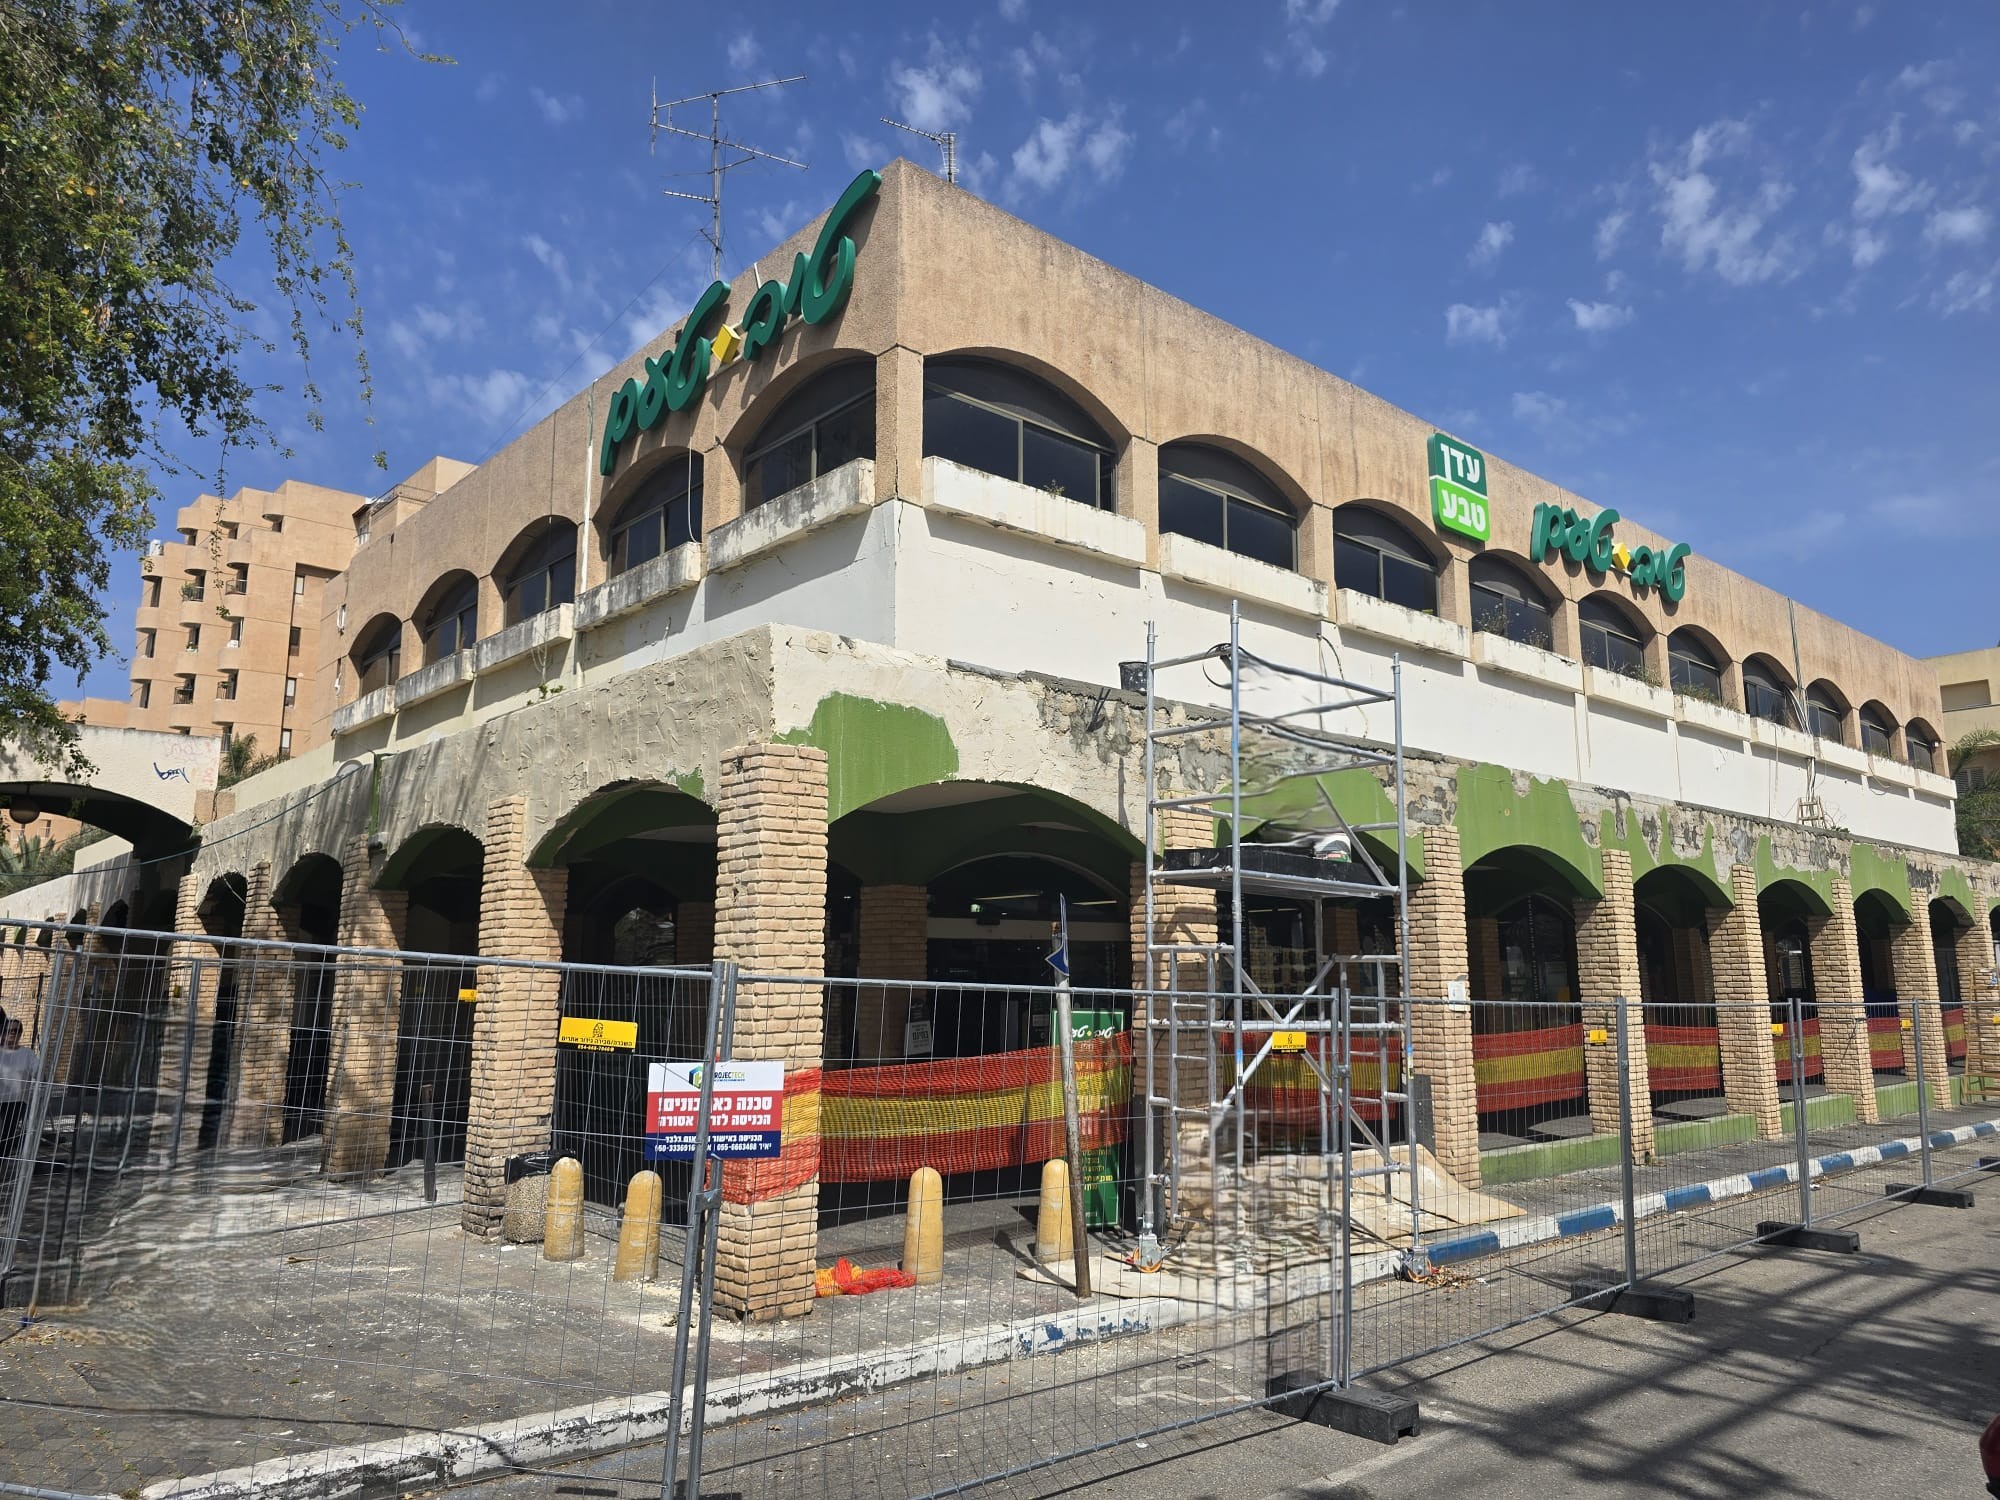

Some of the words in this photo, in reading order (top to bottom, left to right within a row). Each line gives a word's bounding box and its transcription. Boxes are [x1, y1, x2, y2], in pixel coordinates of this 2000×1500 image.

[743, 169, 882, 361] טיב
[600, 280, 731, 476] טעם
[1440, 443, 1480, 483] עדן
[1442, 489, 1486, 532] טבע
[1531, 502, 1620, 572] טעם
[1629, 543, 1692, 602] טיב
[1072, 1024, 1088, 1038] טע
[710, 1097, 732, 1113] כא
[736, 1096, 773, 1110] סכנה
[659, 1115, 694, 1127] אסורה
[710, 1113, 729, 1126] לזר
[731, 1114, 771, 1126] הכניסה
[712, 1135, 737, 1143] באישור
[738, 1134, 762, 1142] הכניסה
[758, 1143, 772, 1151] יאיר
